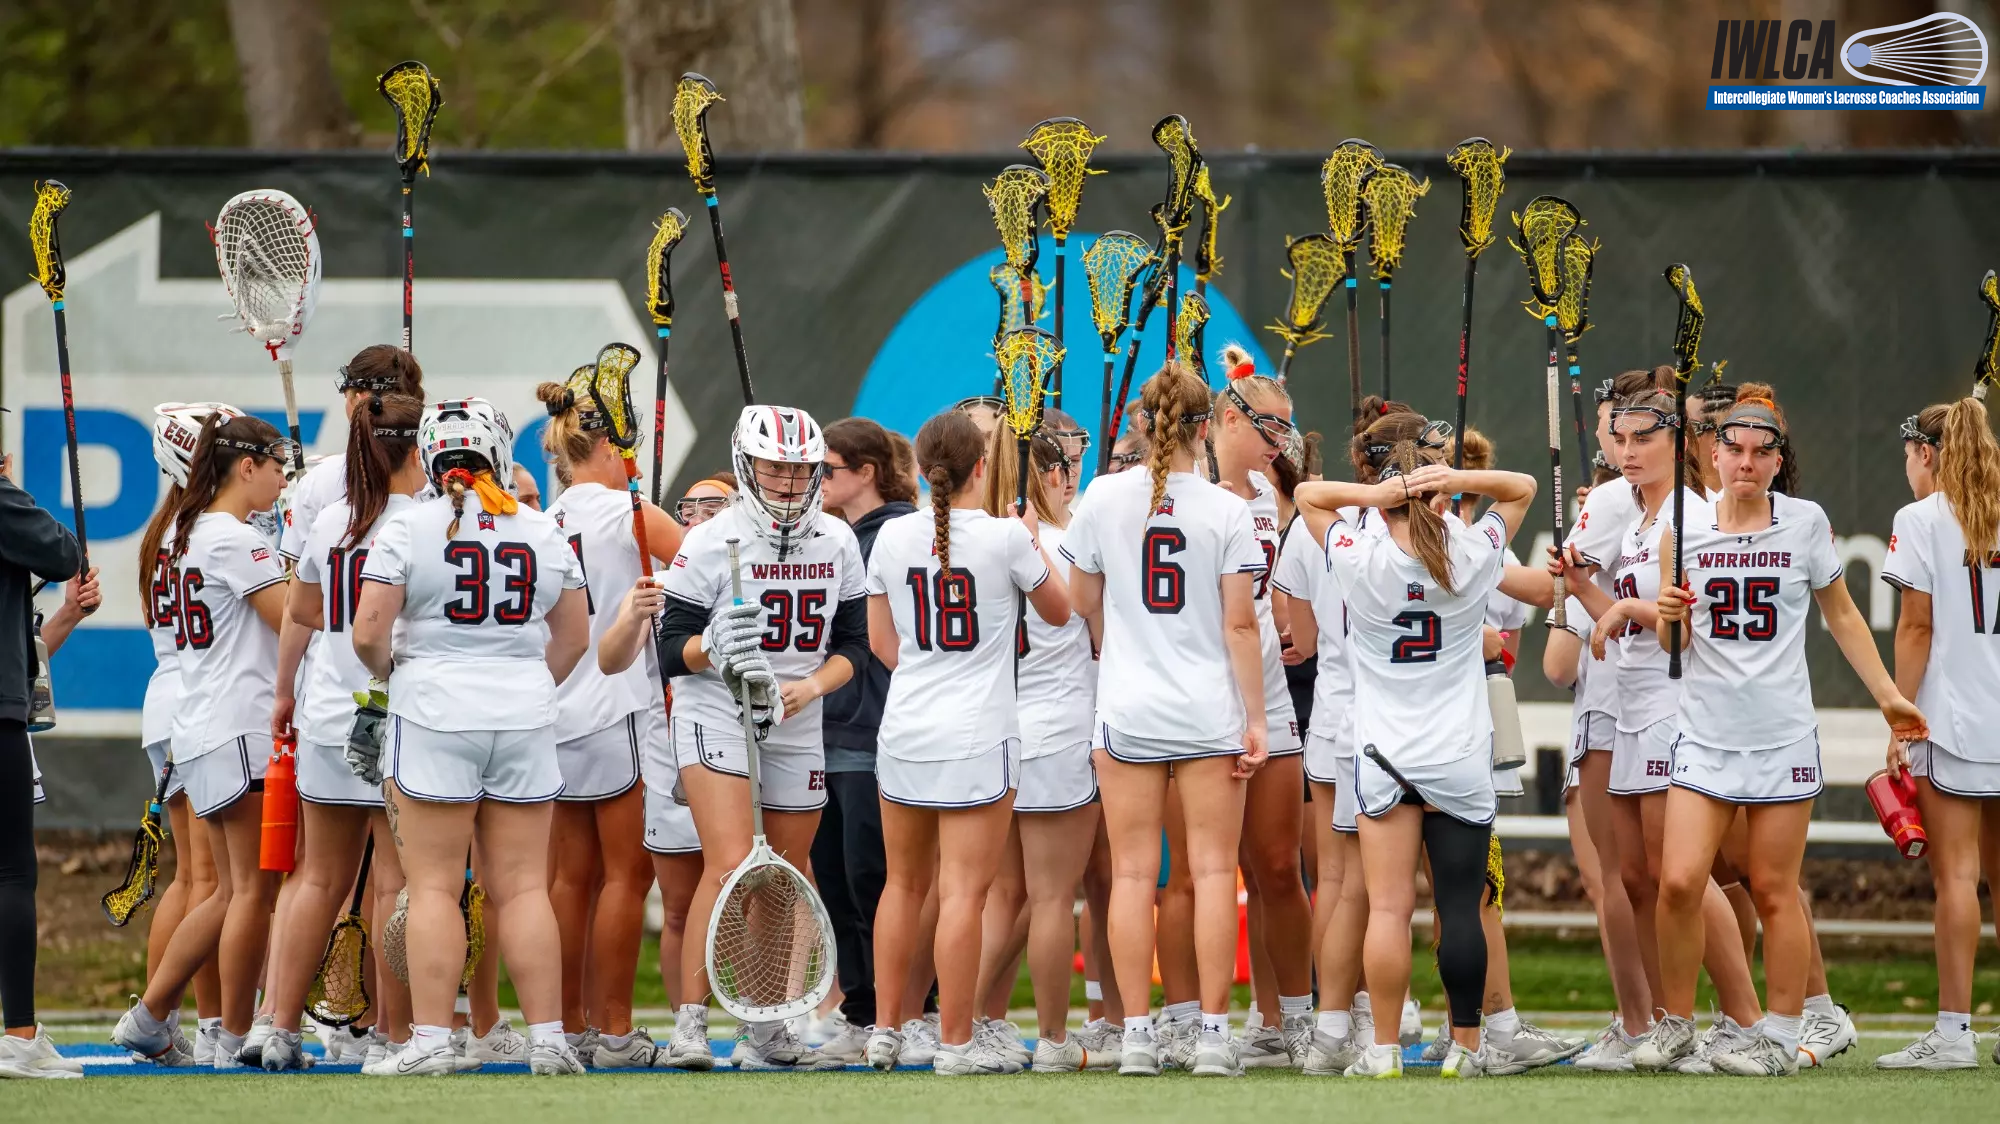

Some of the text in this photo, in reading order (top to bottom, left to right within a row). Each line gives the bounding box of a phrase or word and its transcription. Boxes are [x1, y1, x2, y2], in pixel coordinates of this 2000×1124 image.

[62, 374, 73, 408] STX
[1229, 393, 1245, 409] STX
[164, 420, 197, 452] ESU
[404, 429, 419, 437] ST
[472, 436, 481, 446] 33
[235, 441, 257, 451] STX
[1371, 445, 1390, 453] STX
[1142, 526, 1187, 615] 6
[1697, 551, 1792, 569] WARRIORS
[752, 562, 835, 580] WARRIORS
[444, 541, 538, 626] 33
[906, 566, 980, 653] 18
[1704, 576, 1780, 641] 25
[759, 588, 827, 653] 35
[1390, 610, 1442, 663] 2
[807, 770, 825, 791] ES
[1792, 766, 1816, 783] ESU
